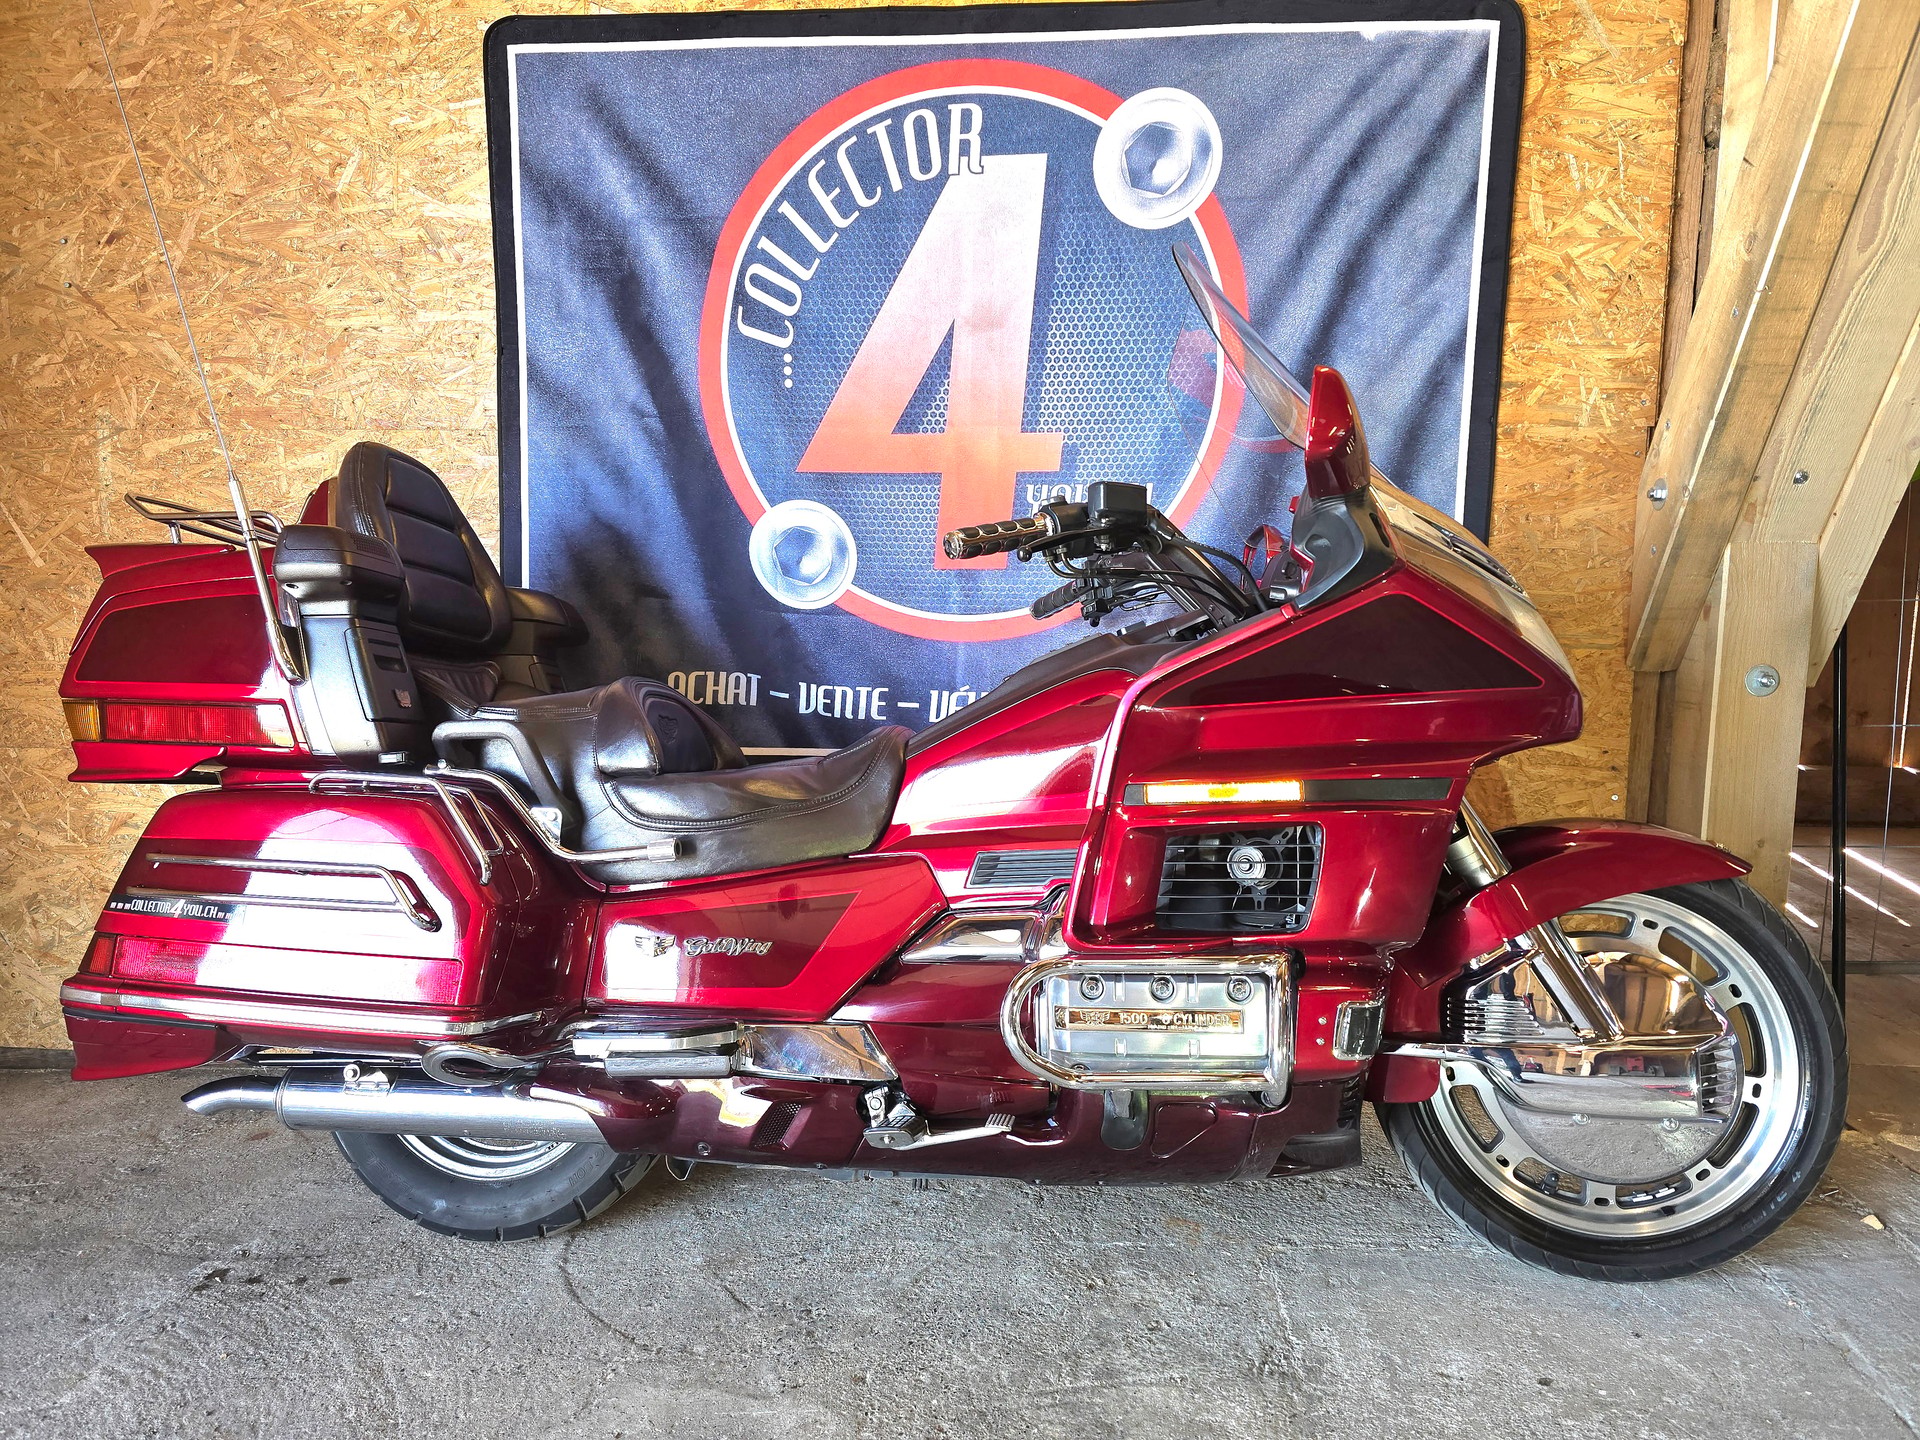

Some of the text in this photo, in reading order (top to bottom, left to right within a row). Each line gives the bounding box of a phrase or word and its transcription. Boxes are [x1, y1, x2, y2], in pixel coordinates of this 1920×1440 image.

[795, 152, 1064, 569] 4
[667, 671, 762, 706] ACHAT
[799, 682, 889, 719] VENTE
[1118, 1012, 1148, 1025] 1500
